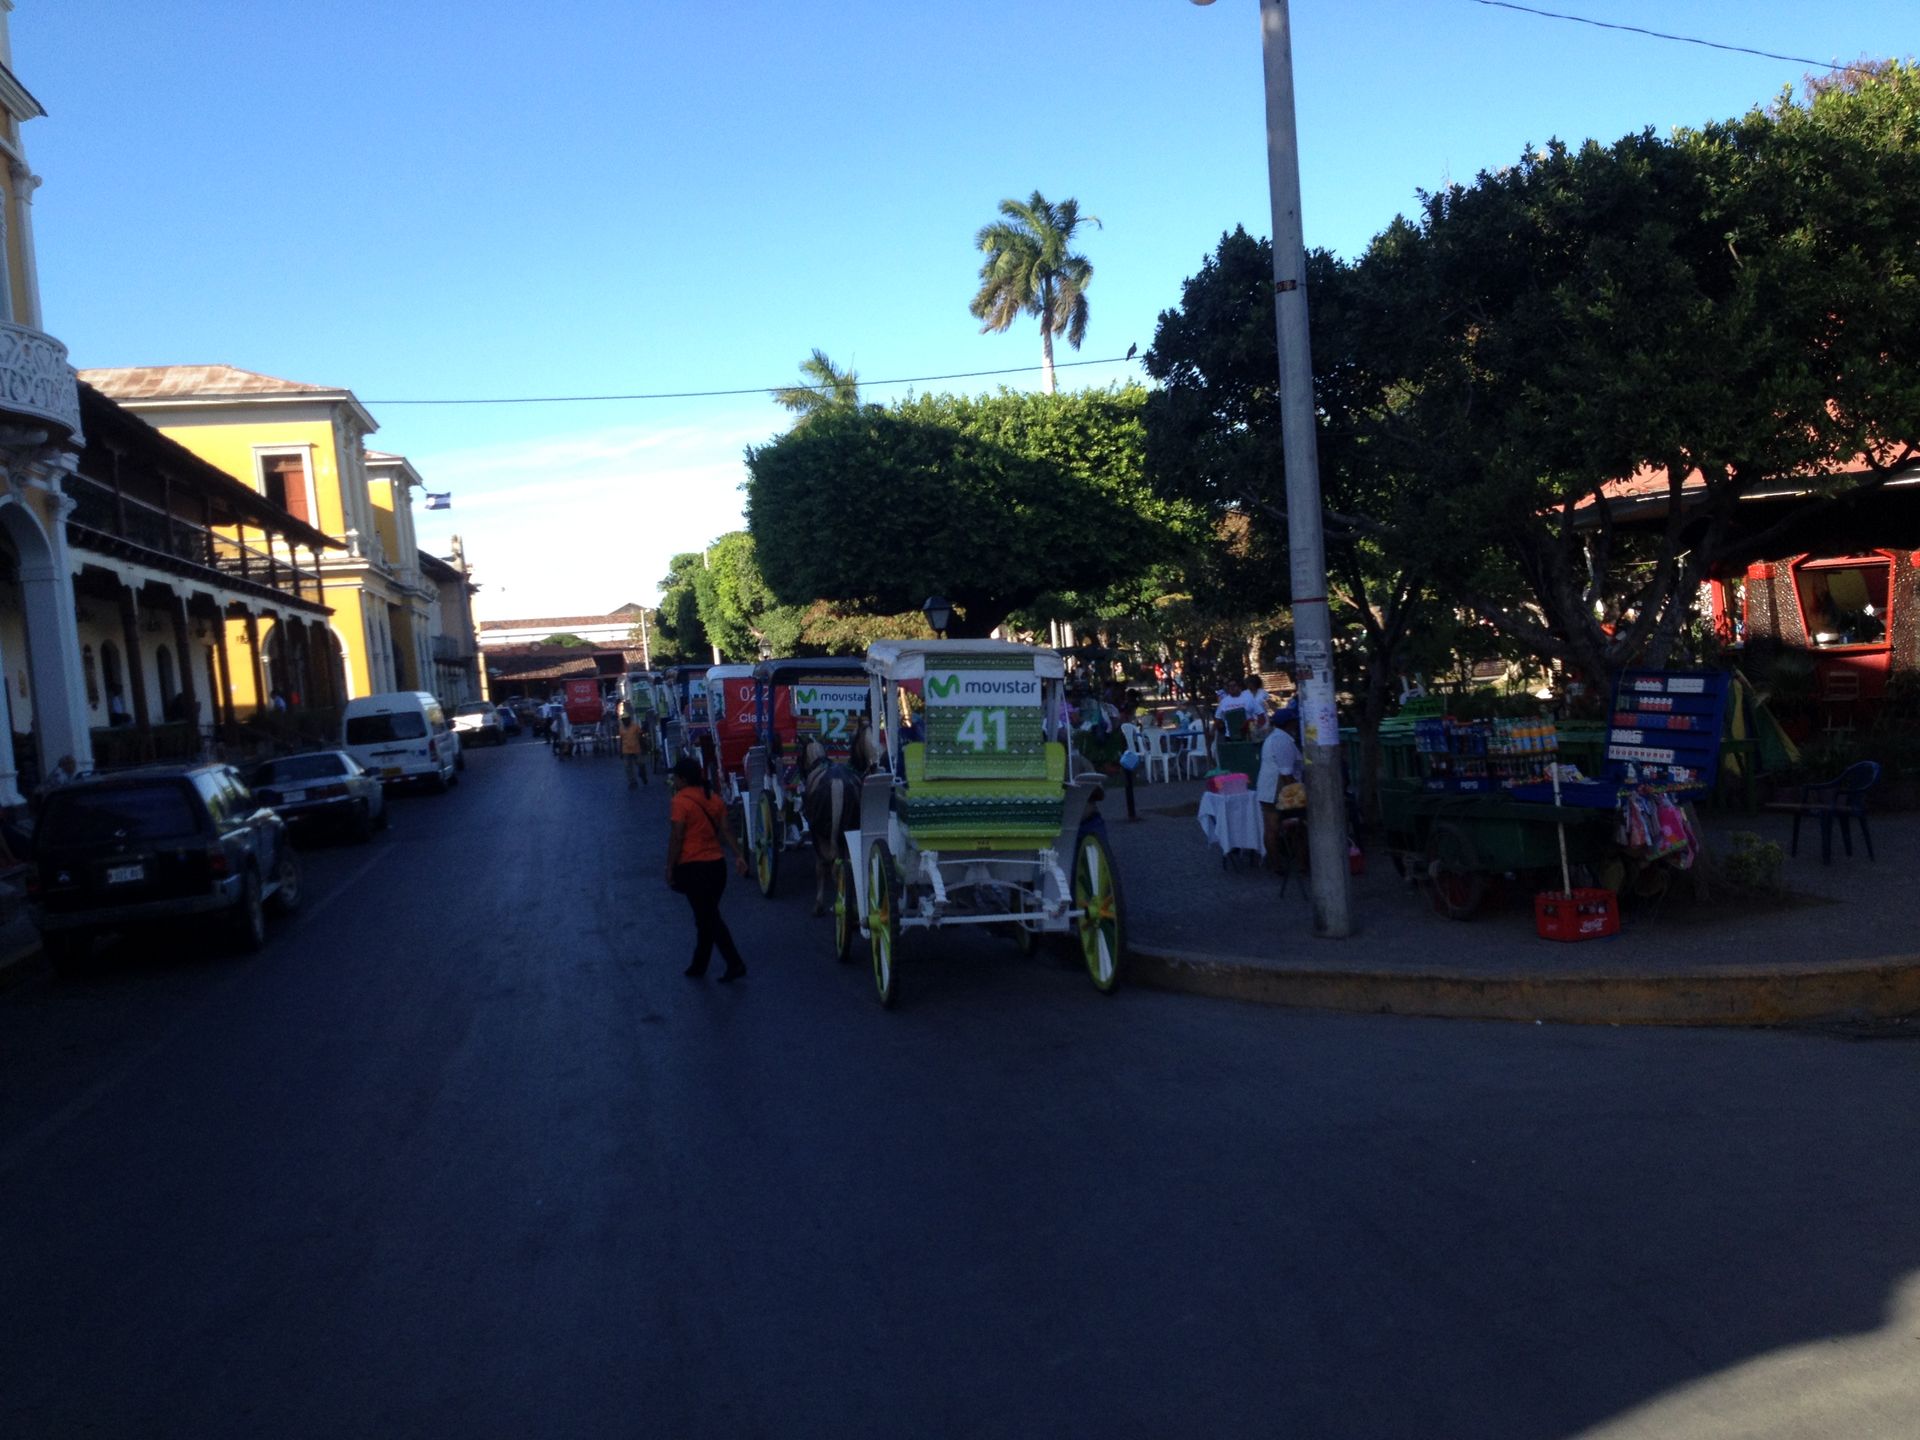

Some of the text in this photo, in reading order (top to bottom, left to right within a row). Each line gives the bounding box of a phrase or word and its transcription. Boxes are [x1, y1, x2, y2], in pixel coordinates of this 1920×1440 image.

[965, 680, 1036, 694] movistar
[815, 711, 849, 739] 12
[957, 710, 1008, 752] 41
